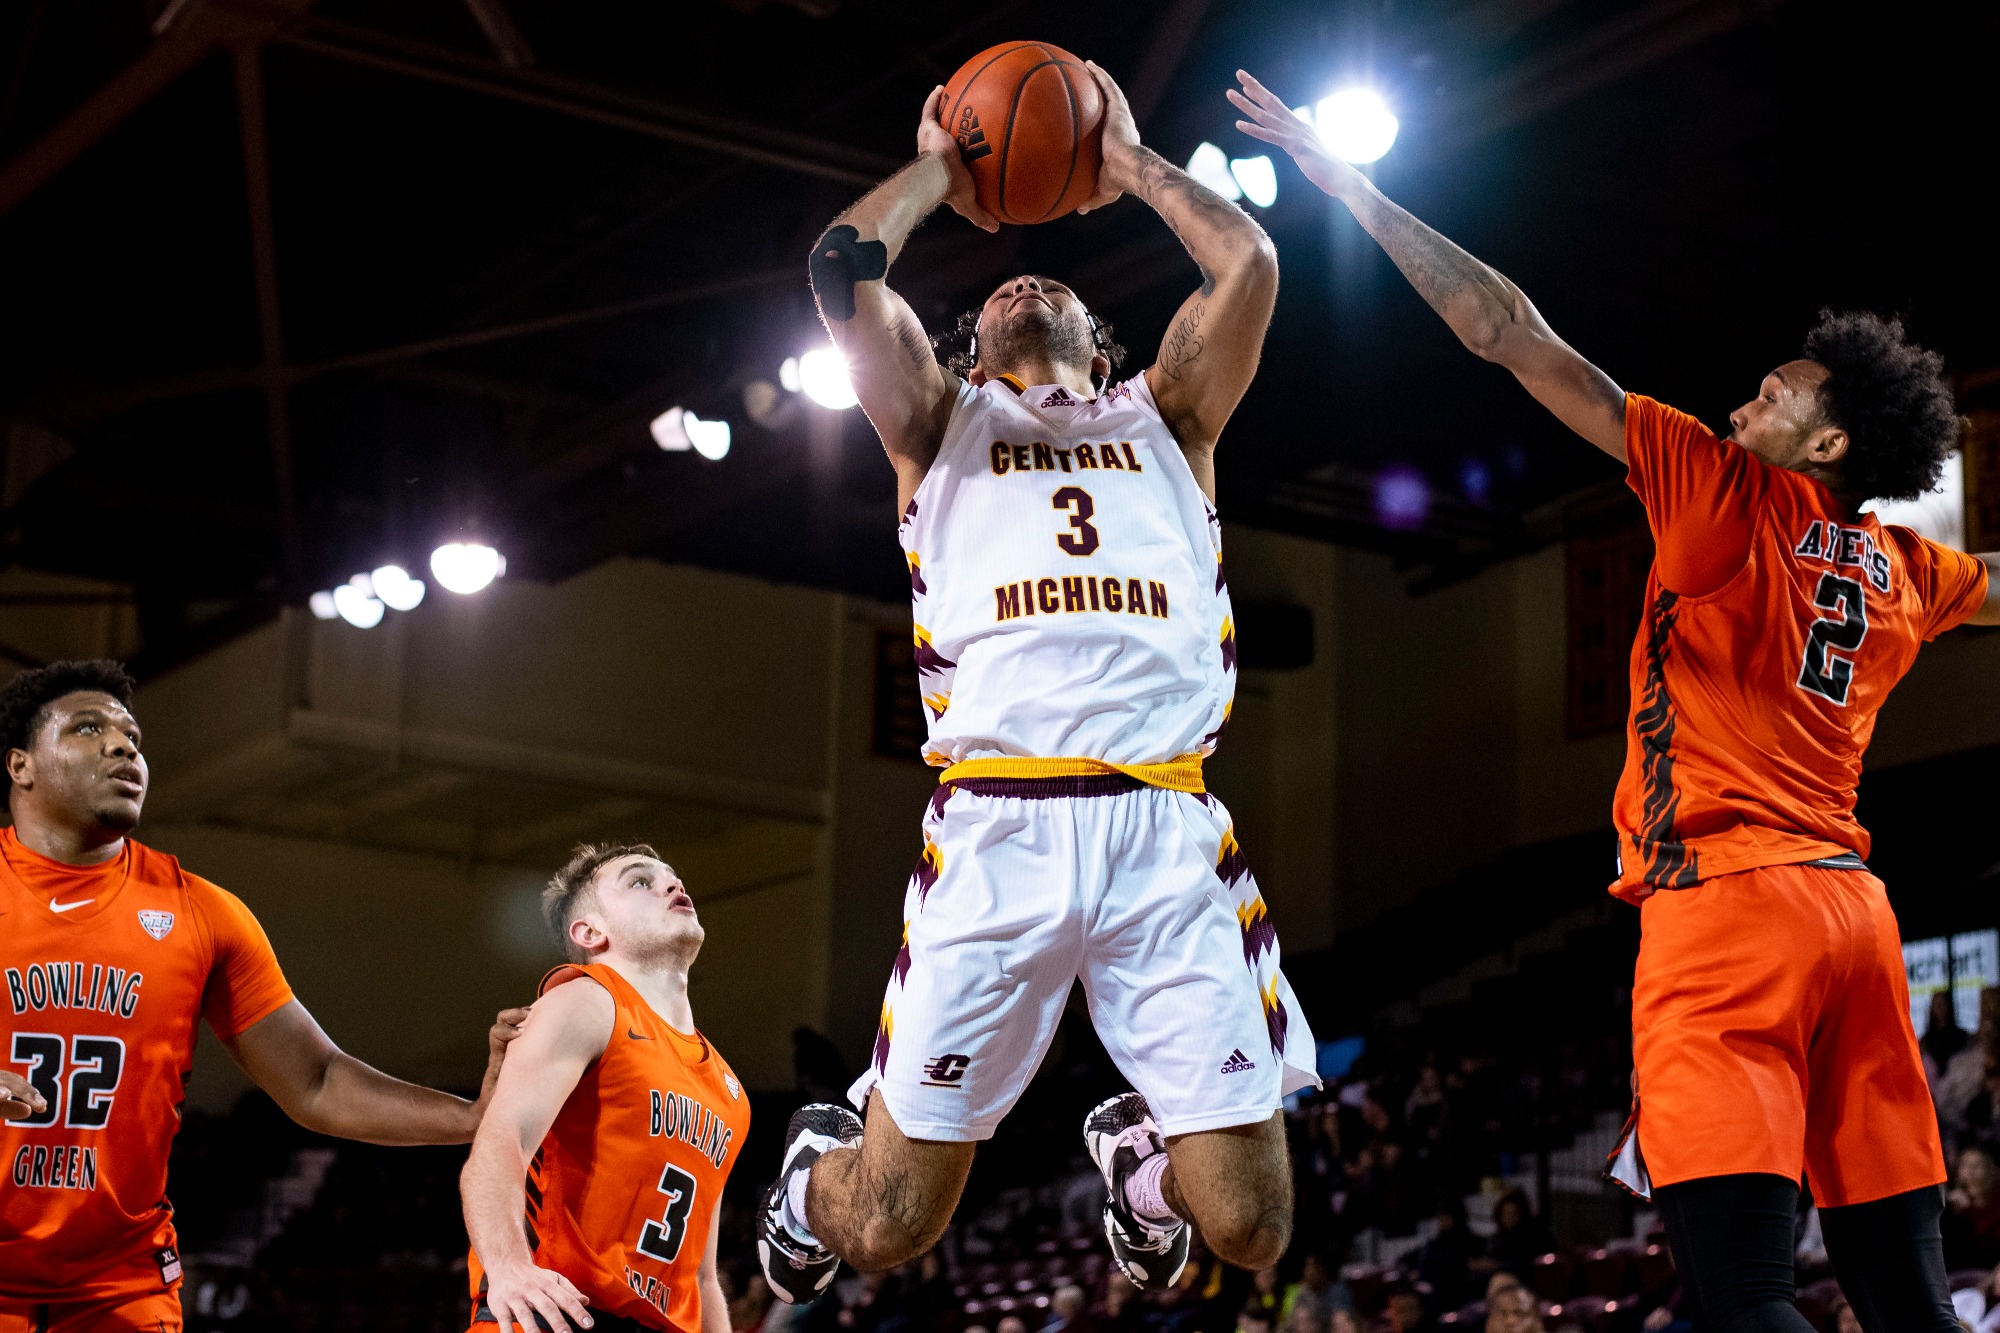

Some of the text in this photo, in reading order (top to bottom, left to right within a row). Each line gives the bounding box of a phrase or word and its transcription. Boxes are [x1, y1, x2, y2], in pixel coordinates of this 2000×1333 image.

[958, 104, 974, 149] adid
[1041, 399, 1075, 409] adidas
[989, 440, 1143, 477] CENTRAL
[1051, 485, 1100, 558] 3
[1794, 519, 1891, 594] AYERS
[994, 575, 1170, 623] MICHIGAN
[1796, 570, 1869, 707] 2
[5, 961, 143, 1019] BOWLING
[5, 1031, 127, 1130] 32
[1220, 1062, 1256, 1075] adidas
[649, 1089, 733, 1171] BOWLING
[13, 1145, 98, 1191] GREEN
[636, 1161, 698, 1265] 3
[162, 1250, 176, 1263] XL
